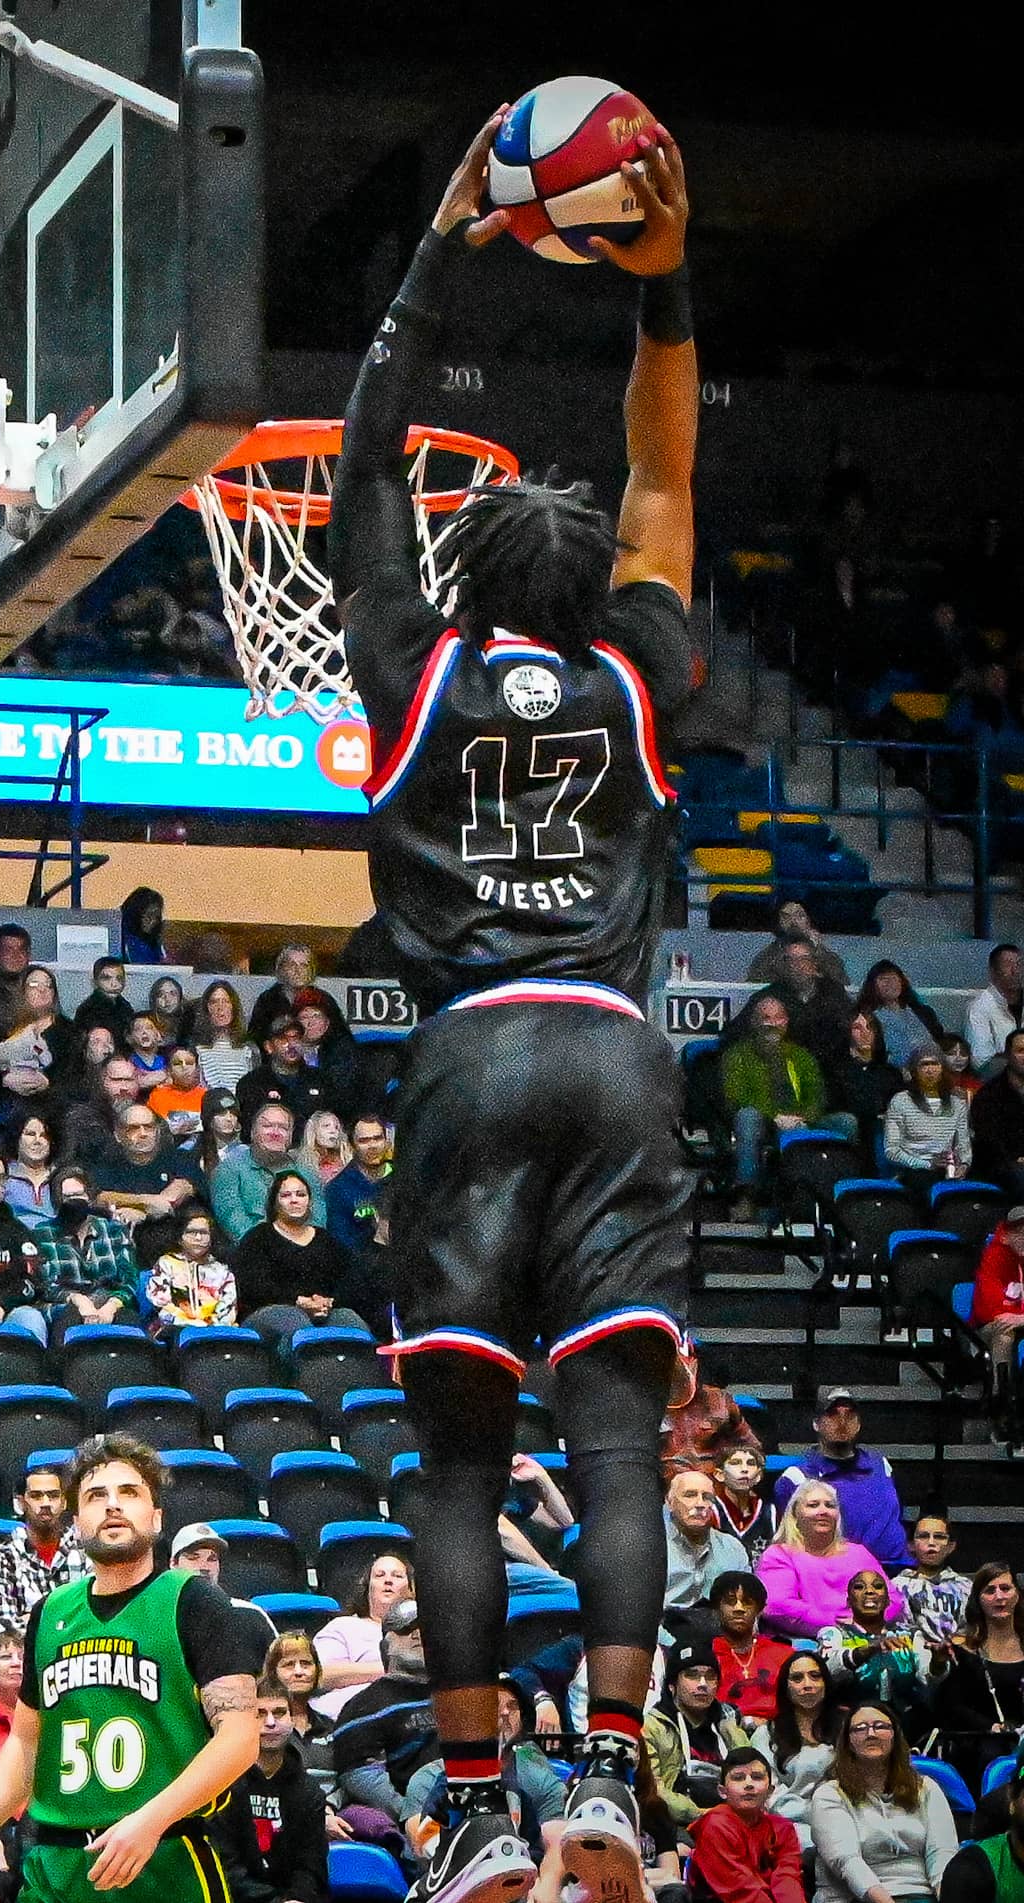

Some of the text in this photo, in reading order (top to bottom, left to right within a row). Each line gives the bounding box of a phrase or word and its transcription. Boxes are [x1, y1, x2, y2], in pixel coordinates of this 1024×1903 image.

[98, 727, 184, 764] THE
[196, 731, 304, 769] BMO
[462, 728, 611, 862] 17
[476, 873, 594, 911] DIESEL
[352, 989, 408, 1022] 103
[670, 998, 725, 1032] 104
[62, 1638, 134, 1659] WASHINGTON
[42, 1652, 159, 1708] GENERALS
[59, 1715, 147, 1795] 50
